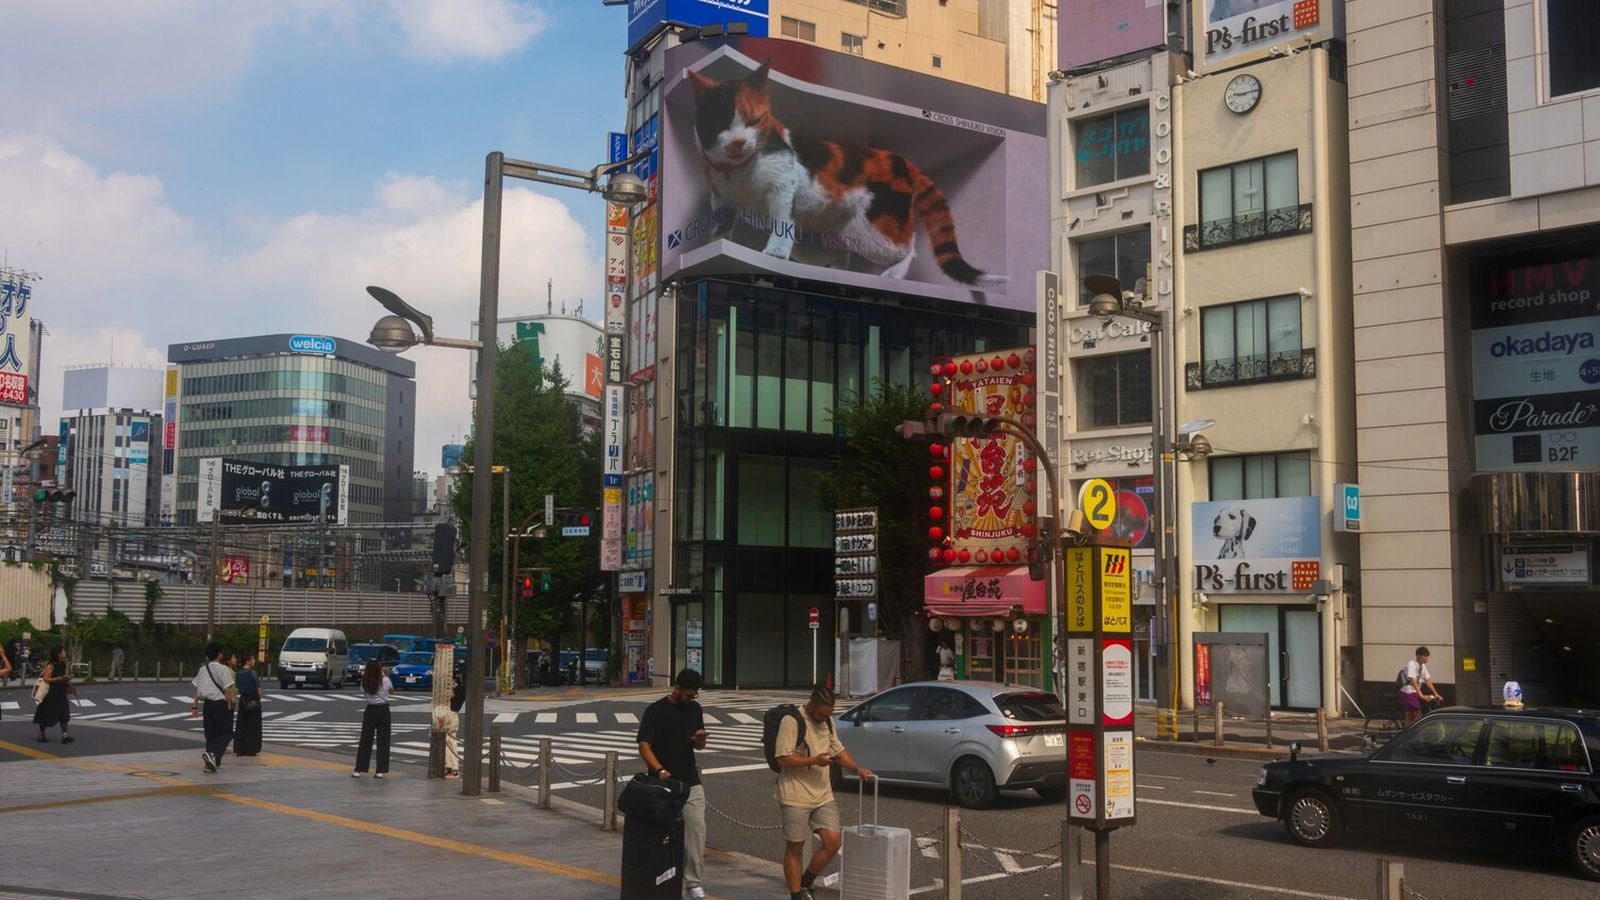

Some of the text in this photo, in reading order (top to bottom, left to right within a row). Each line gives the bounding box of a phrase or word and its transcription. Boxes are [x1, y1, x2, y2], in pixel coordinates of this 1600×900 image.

[1488, 259, 1590, 298] HMV
[0, 273, 31, 319] オケ
[1491, 288, 1591, 312] record shop
[292, 339, 333, 351] welcia
[1490, 331, 1595, 358] okadaya
[971, 377, 1013, 389] YATAIEN
[1489, 398, 1592, 432] Parade
[1548, 446, 1579, 462] B2F
[225, 463, 285, 479] THEグローバル社
[1091, 484, 1110, 522] 2
[970, 528, 1014, 538] SHINJUKU
[1194, 562, 1288, 591] P's-first
[1074, 552, 1085, 627] はとバスのりば
[1104, 615, 1128, 626] はとバス
[1077, 645, 1087, 718] 新宿駅東口
[1406, 812, 1428, 822] TAXI
